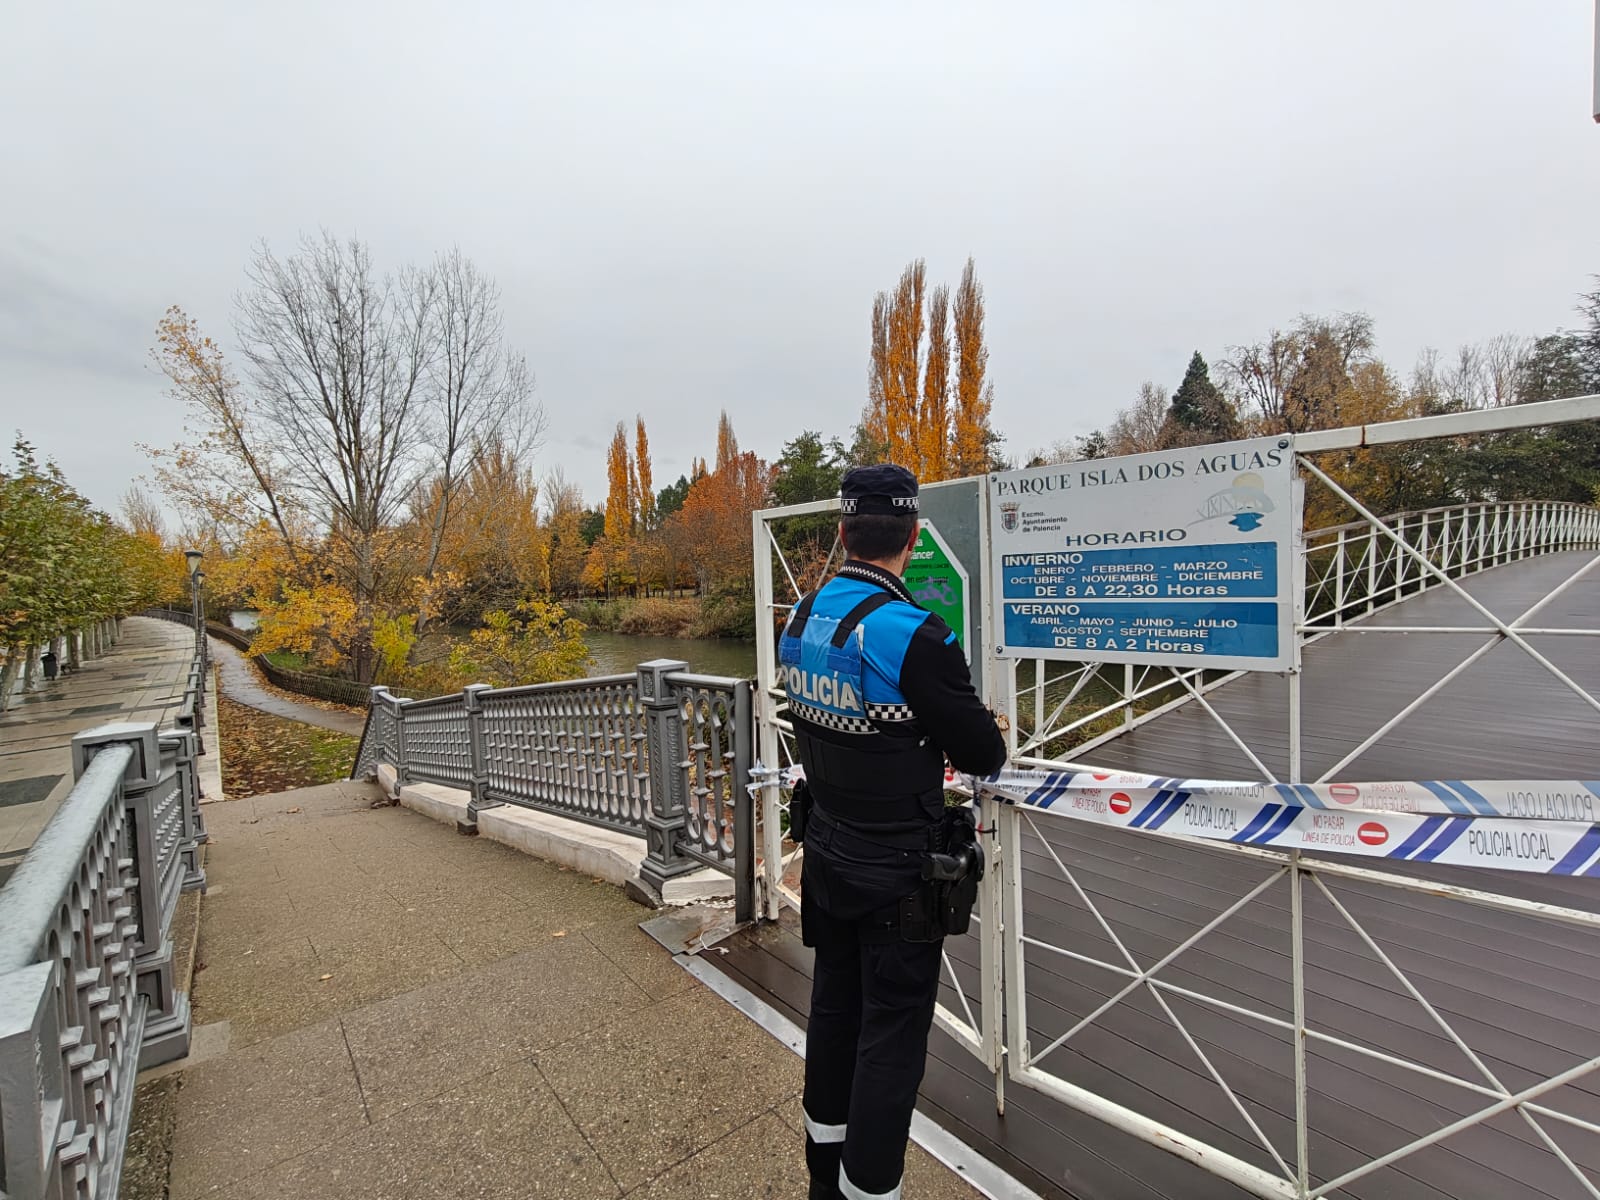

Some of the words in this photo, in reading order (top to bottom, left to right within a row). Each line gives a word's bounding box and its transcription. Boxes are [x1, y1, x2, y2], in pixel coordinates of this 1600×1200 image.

[997, 473, 1071, 497] PARQUE
[1080, 468, 1128, 487] ISLA
[1138, 460, 1184, 481] DOS
[1195, 449, 1282, 475] AGUAS
[1022, 517, 1068, 525] Ayuntamiento
[1066, 528, 1187, 547] HORARIO
[1004, 553, 1083, 566] INVIERNO
[1034, 566, 1075, 575] ENERO
[1092, 563, 1154, 574] FEBRERO
[1173, 561, 1228, 571] MARZO
[1010, 576, 1065, 584] OCTUBRE
[1082, 573, 1158, 583] NOVIEMBRE
[1179, 571, 1263, 581] DICIEMBRE
[1035, 585, 1058, 596] DE
[1065, 585, 1077, 596] 8
[1084, 585, 1097, 596] A
[1167, 583, 1228, 596] Horas
[1011, 604, 1080, 616] VERANO
[1030, 617, 1063, 625] ABRIL
[1080, 617, 1115, 626] MAYO
[1132, 618, 1174, 627] JUNIO
[1194, 619, 1238, 628] JULIO
[1051, 626, 1102, 635] AGOSTO
[1120, 627, 1209, 638] SEPTIEMBRE
[1054, 636, 1077, 647] DE
[1085, 637, 1097, 648] 8
[1104, 638, 1118, 649] A
[1126, 638, 1138, 650] 2
[1146, 639, 1205, 652] Horas
[1184, 803, 1212, 828] POLICIA
[1213, 807, 1238, 831] LOCAL
[1313, 814, 1323, 828] NO
[1324, 815, 1345, 830] PASAR
[1302, 831, 1320, 843] LINEA
[1320, 832, 1330, 843] DE
[1331, 833, 1355, 846] POLICIA
[1468, 830, 1513, 857] POLICIA
[1514, 832, 1555, 861] LOCAL
